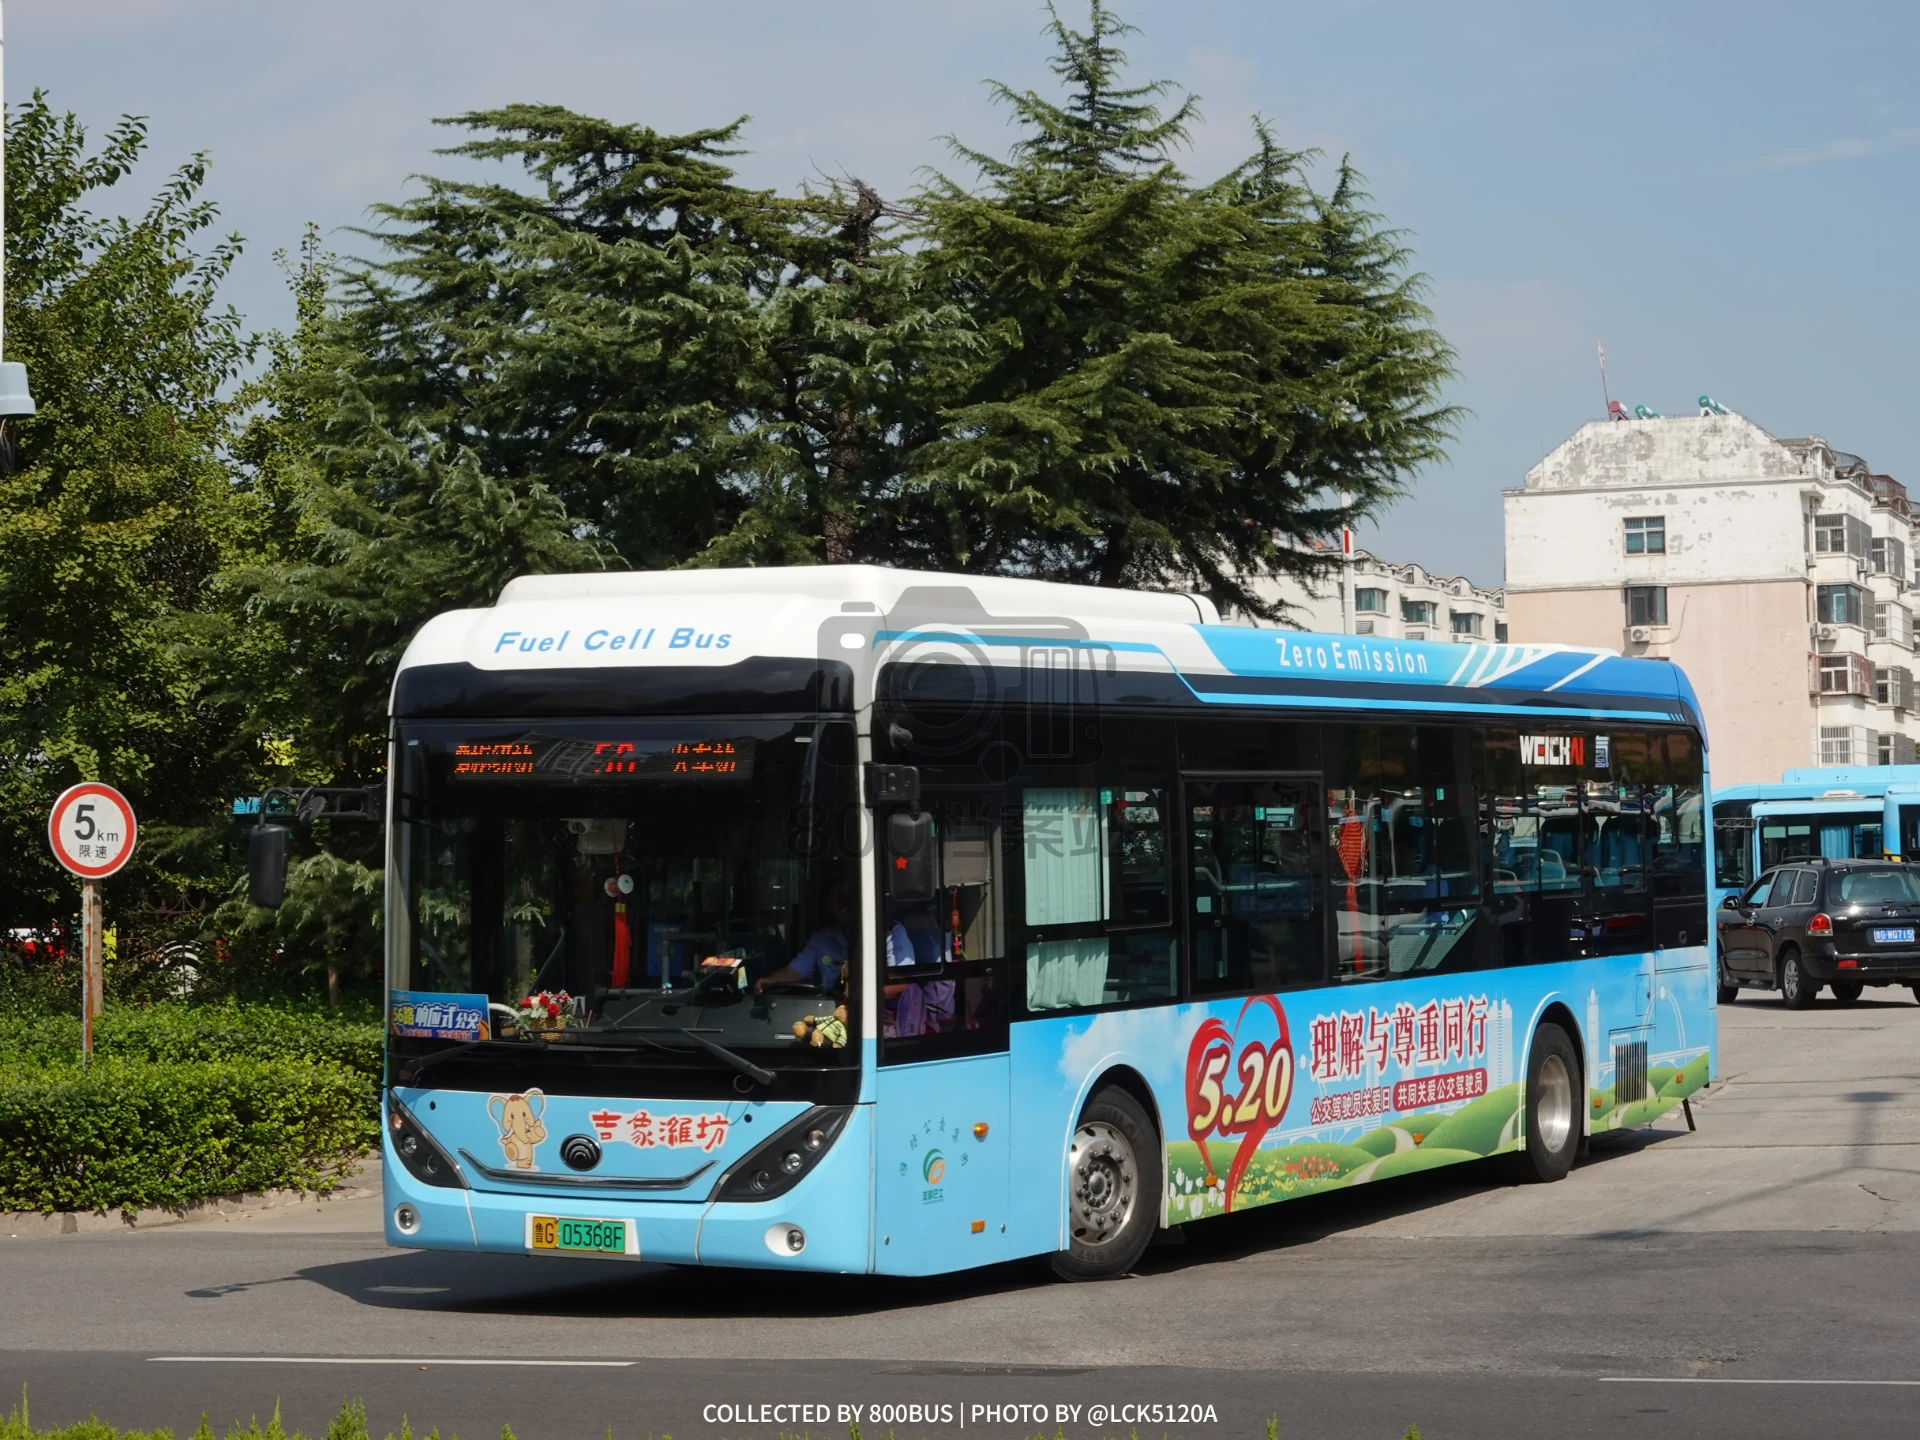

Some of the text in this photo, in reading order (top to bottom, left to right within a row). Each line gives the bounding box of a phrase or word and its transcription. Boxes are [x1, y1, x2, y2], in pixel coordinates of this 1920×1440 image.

[494, 627, 732, 653] Fuel Cell Bus
[1275, 638, 1428, 674] Zero Emission
[79, 844, 108, 859] 限速
[1311, 997, 1488, 1080] 理解与尊重同行
[1192, 1045, 1295, 1133] 5.20
[1311, 1071, 1484, 1124] 公交驾驶员关爱日 共同关爱公交驾驶员
[534, 1222, 623, 1249] 鲁G 05368F
